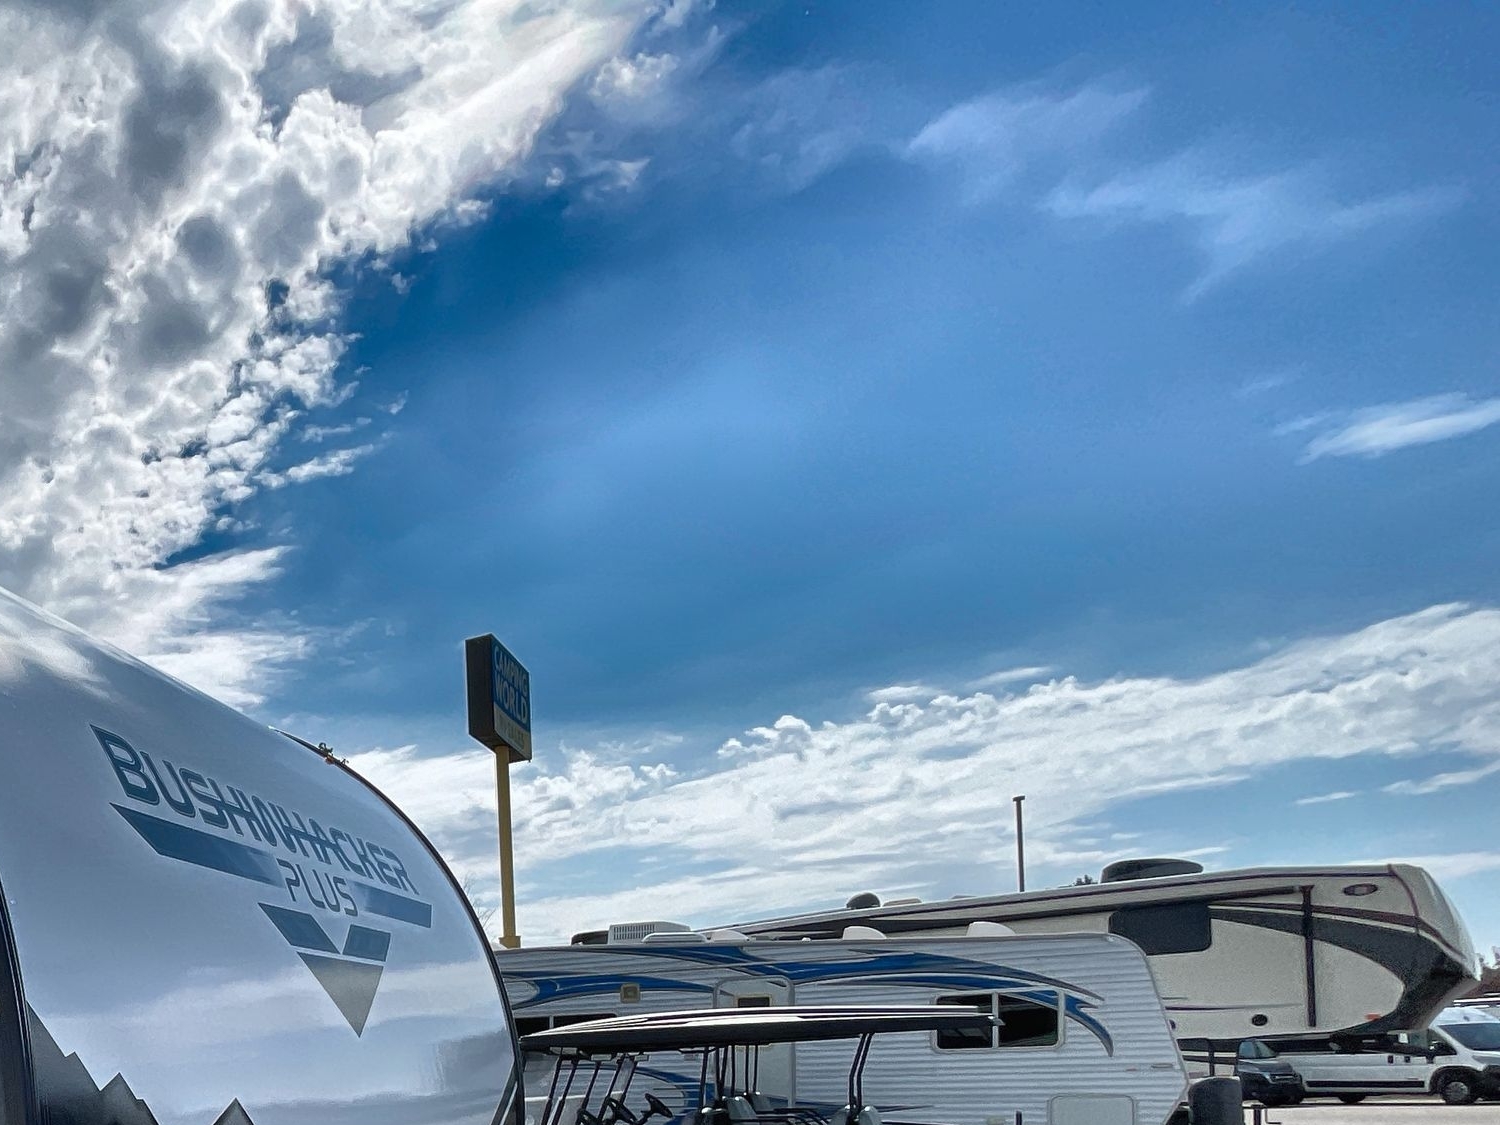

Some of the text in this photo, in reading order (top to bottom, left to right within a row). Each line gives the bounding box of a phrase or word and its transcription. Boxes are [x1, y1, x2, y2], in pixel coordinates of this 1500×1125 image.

[494, 645, 528, 698] CAMPING
[494, 671, 528, 724] WORLD
[90, 724, 420, 895] BUSHWHACKER
[276, 858, 359, 917] PLUS
